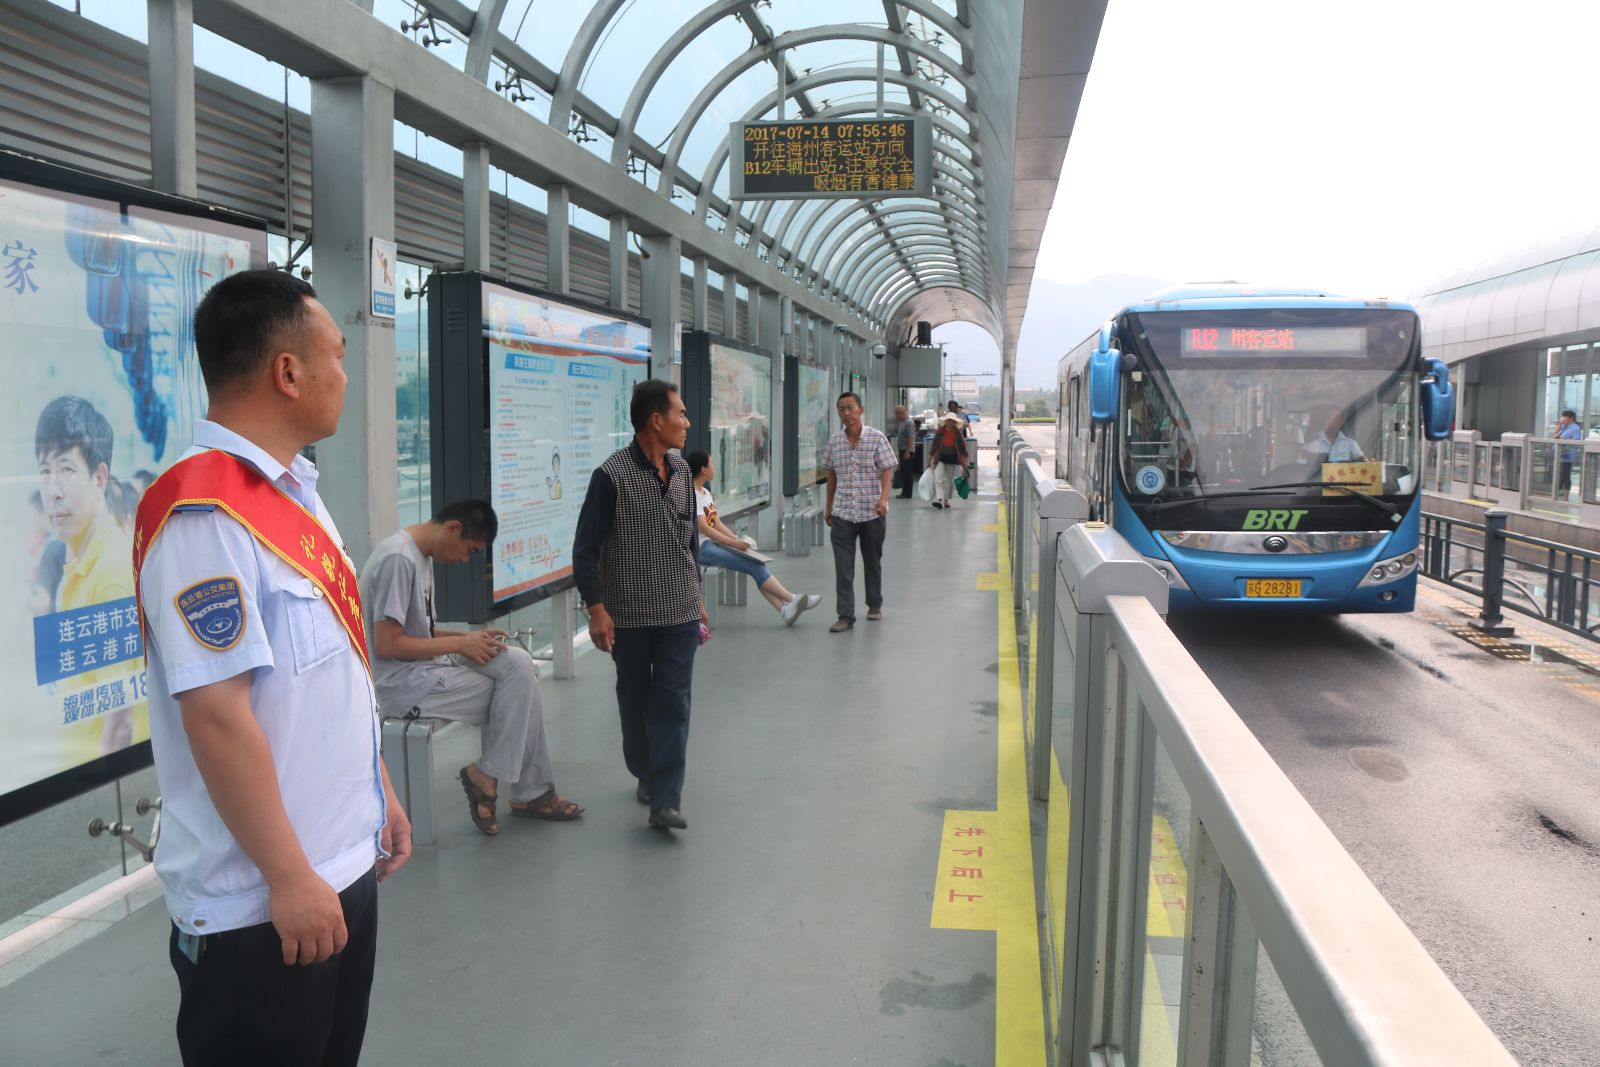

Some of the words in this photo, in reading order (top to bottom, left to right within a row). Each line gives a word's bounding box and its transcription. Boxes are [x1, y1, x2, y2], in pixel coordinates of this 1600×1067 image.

[744, 125, 829, 141] 2017-07-14
[837, 123, 906, 138] 07:56:46
[753, 140, 905, 159] 开往海州客运站方向
[814, 173, 914, 191] 吸烟有害健康
[3, 240, 39, 295] 家
[1242, 509, 1308, 530] BRT
[180, 582, 235, 608] 连云港公交集团
[58, 604, 139, 643] 连云港市交
[58, 633, 139, 673] 连云港市
[949, 826, 986, 903] 先下后上
